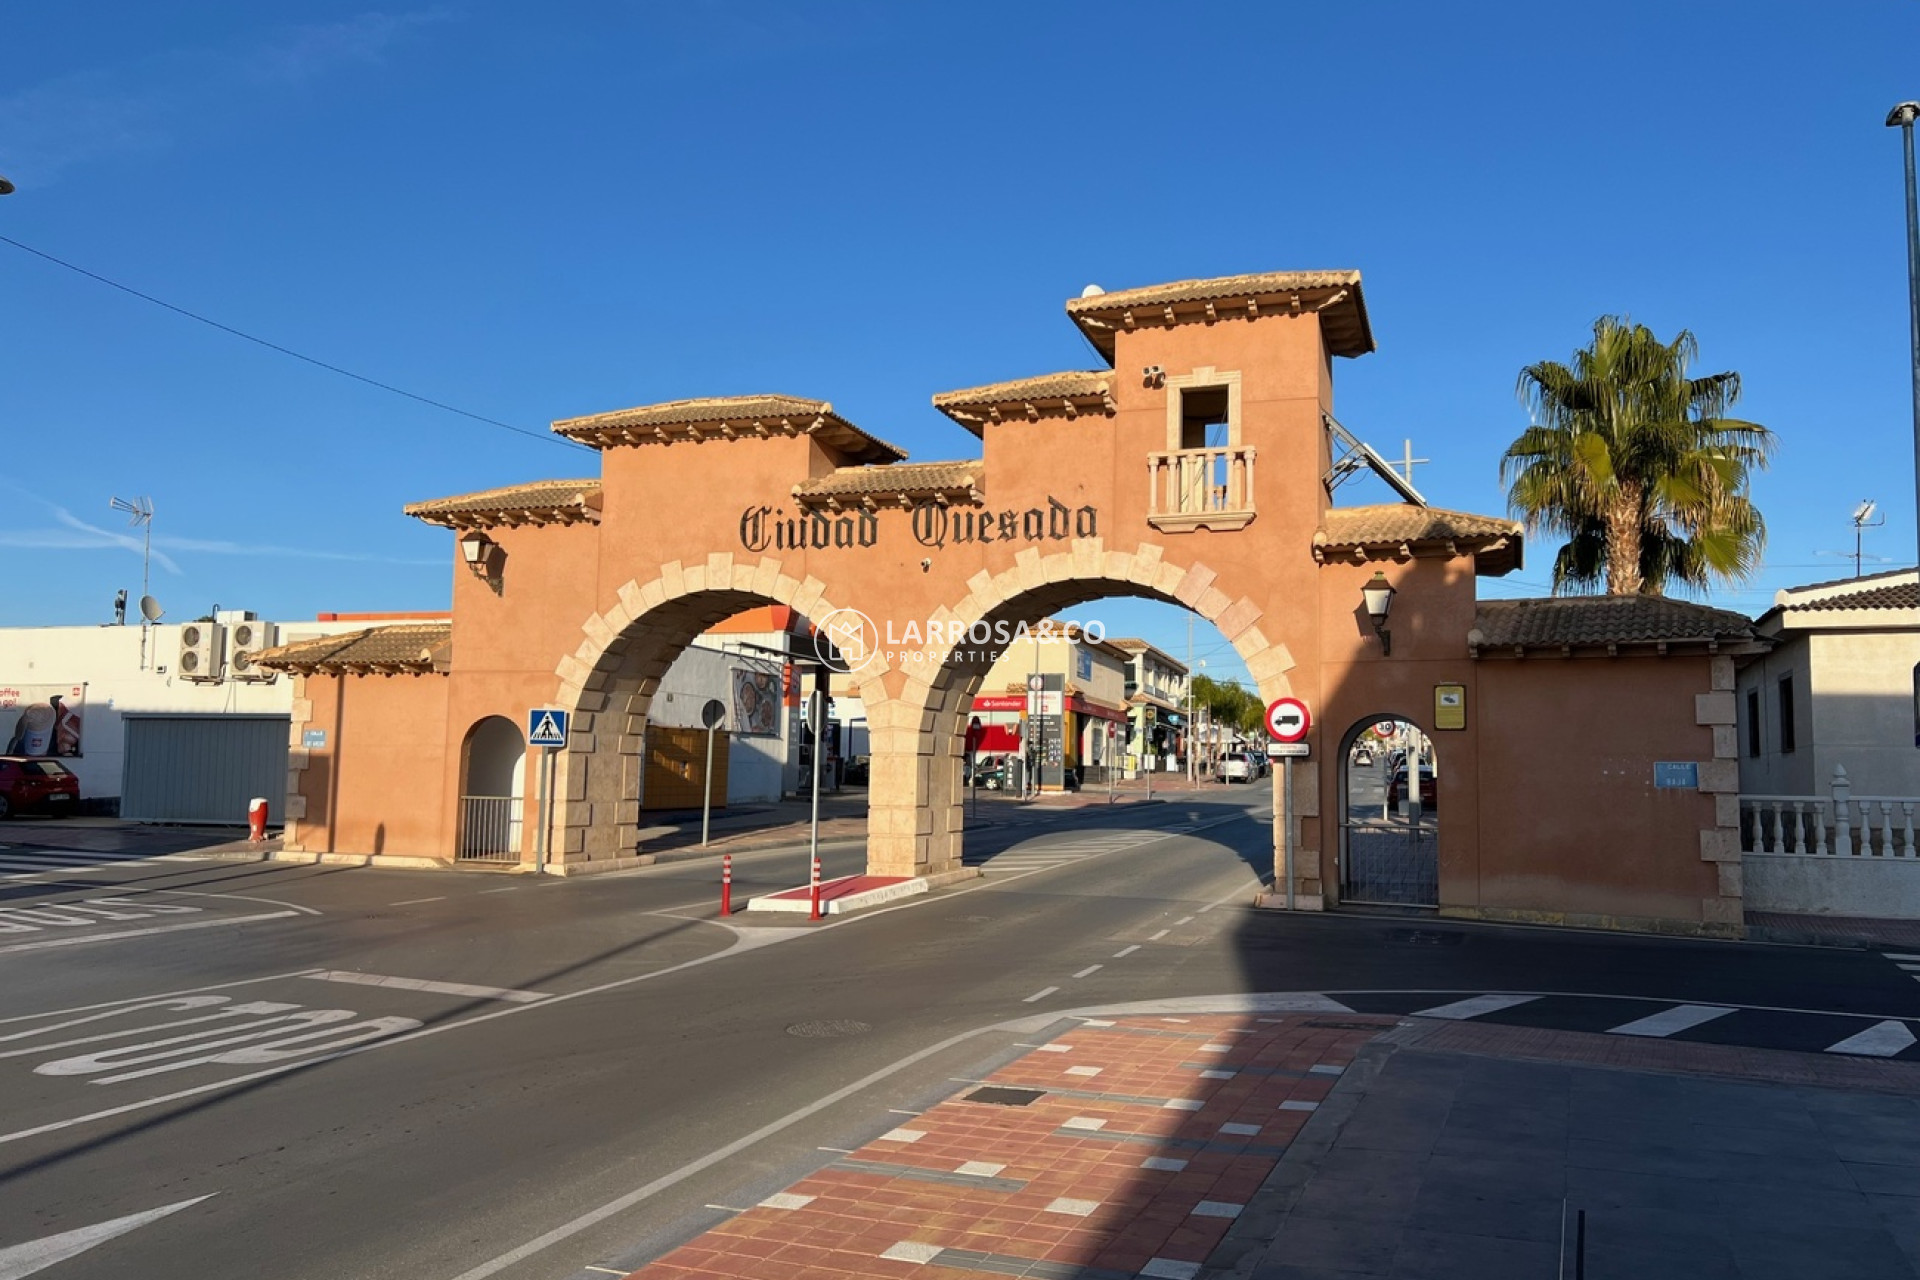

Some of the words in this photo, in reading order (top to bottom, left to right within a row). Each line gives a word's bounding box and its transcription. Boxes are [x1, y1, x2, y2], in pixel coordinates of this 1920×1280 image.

[740, 503, 879, 552] Ciudad
[912, 495, 1098, 550] Quesada
[991, 699, 1022, 707] Santander
